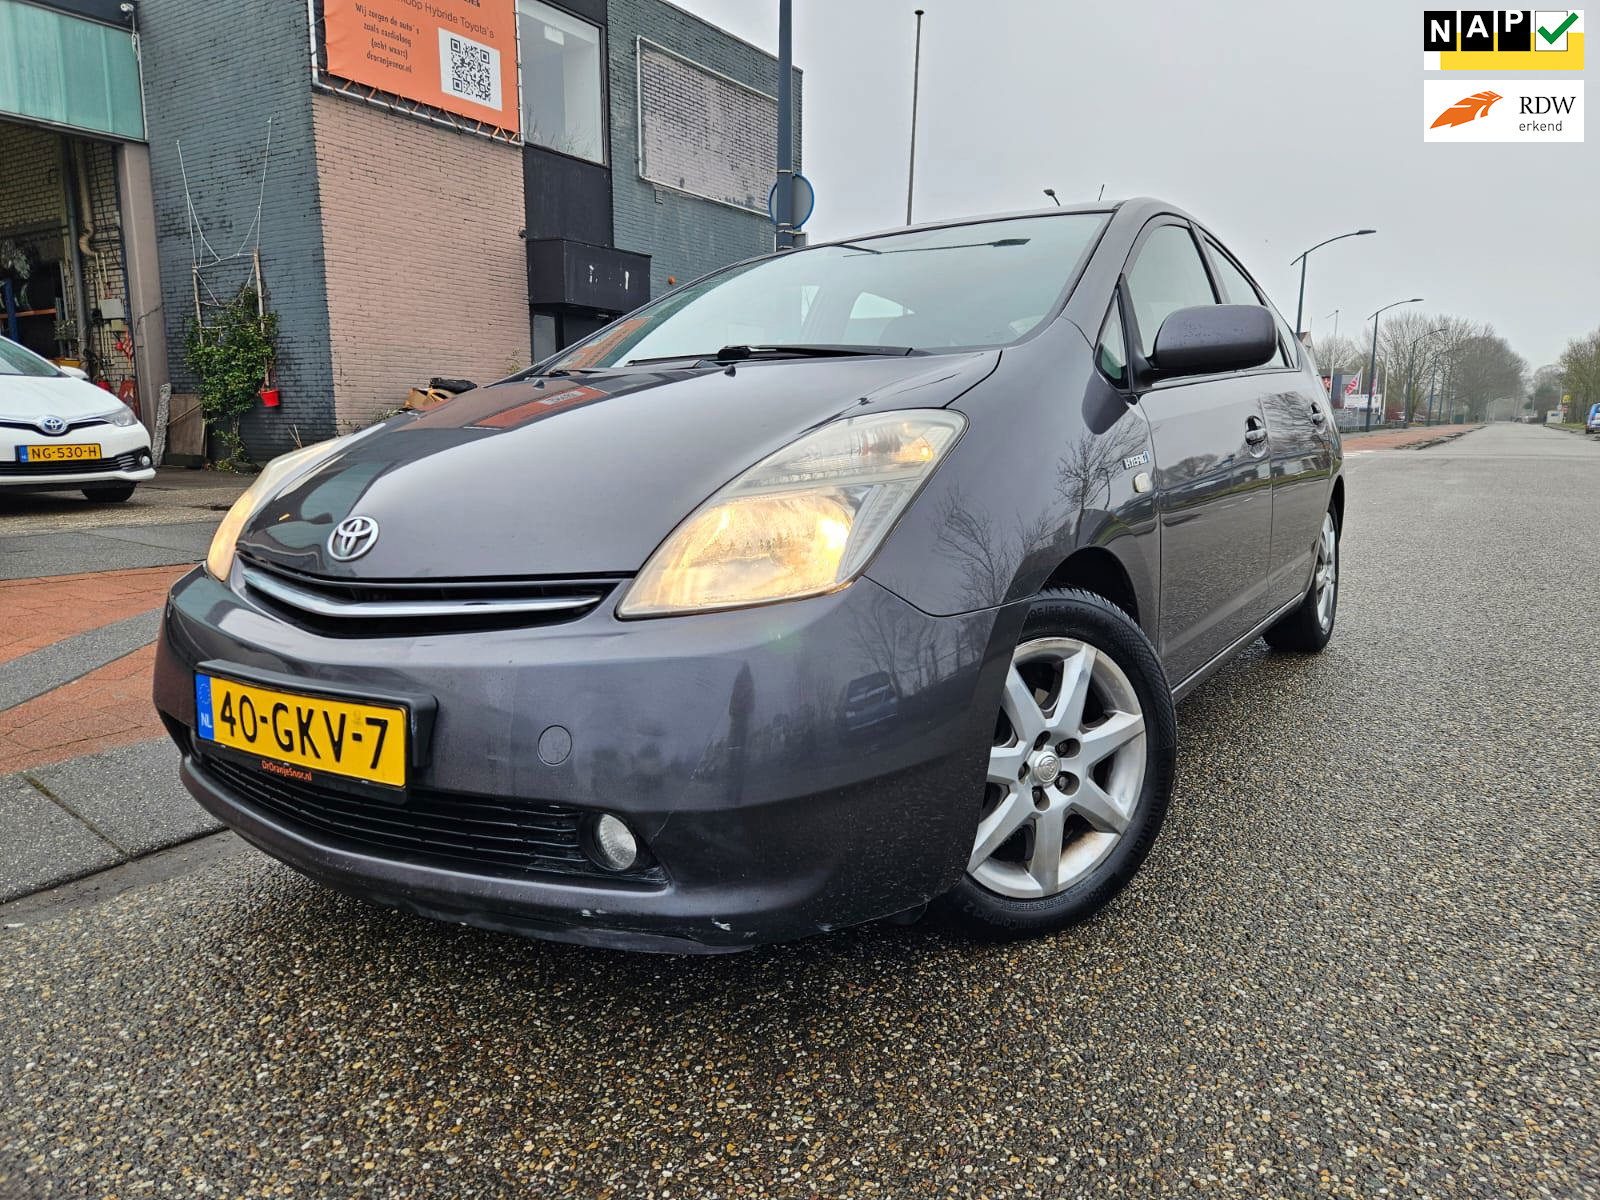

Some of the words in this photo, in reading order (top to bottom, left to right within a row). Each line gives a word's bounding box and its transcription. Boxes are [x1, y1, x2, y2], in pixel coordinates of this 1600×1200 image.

[355, 3, 367, 17] Wij
[368, 10, 389, 23] zorgen
[390, 16, 397, 26] de
[425, 3, 458, 24] Hybride
[363, 22, 380, 34] zoals
[31, 446, 98, 460] NG-530-H
[201, 711, 213, 729] NL
[219, 690, 389, 770] 40-GKV-7
